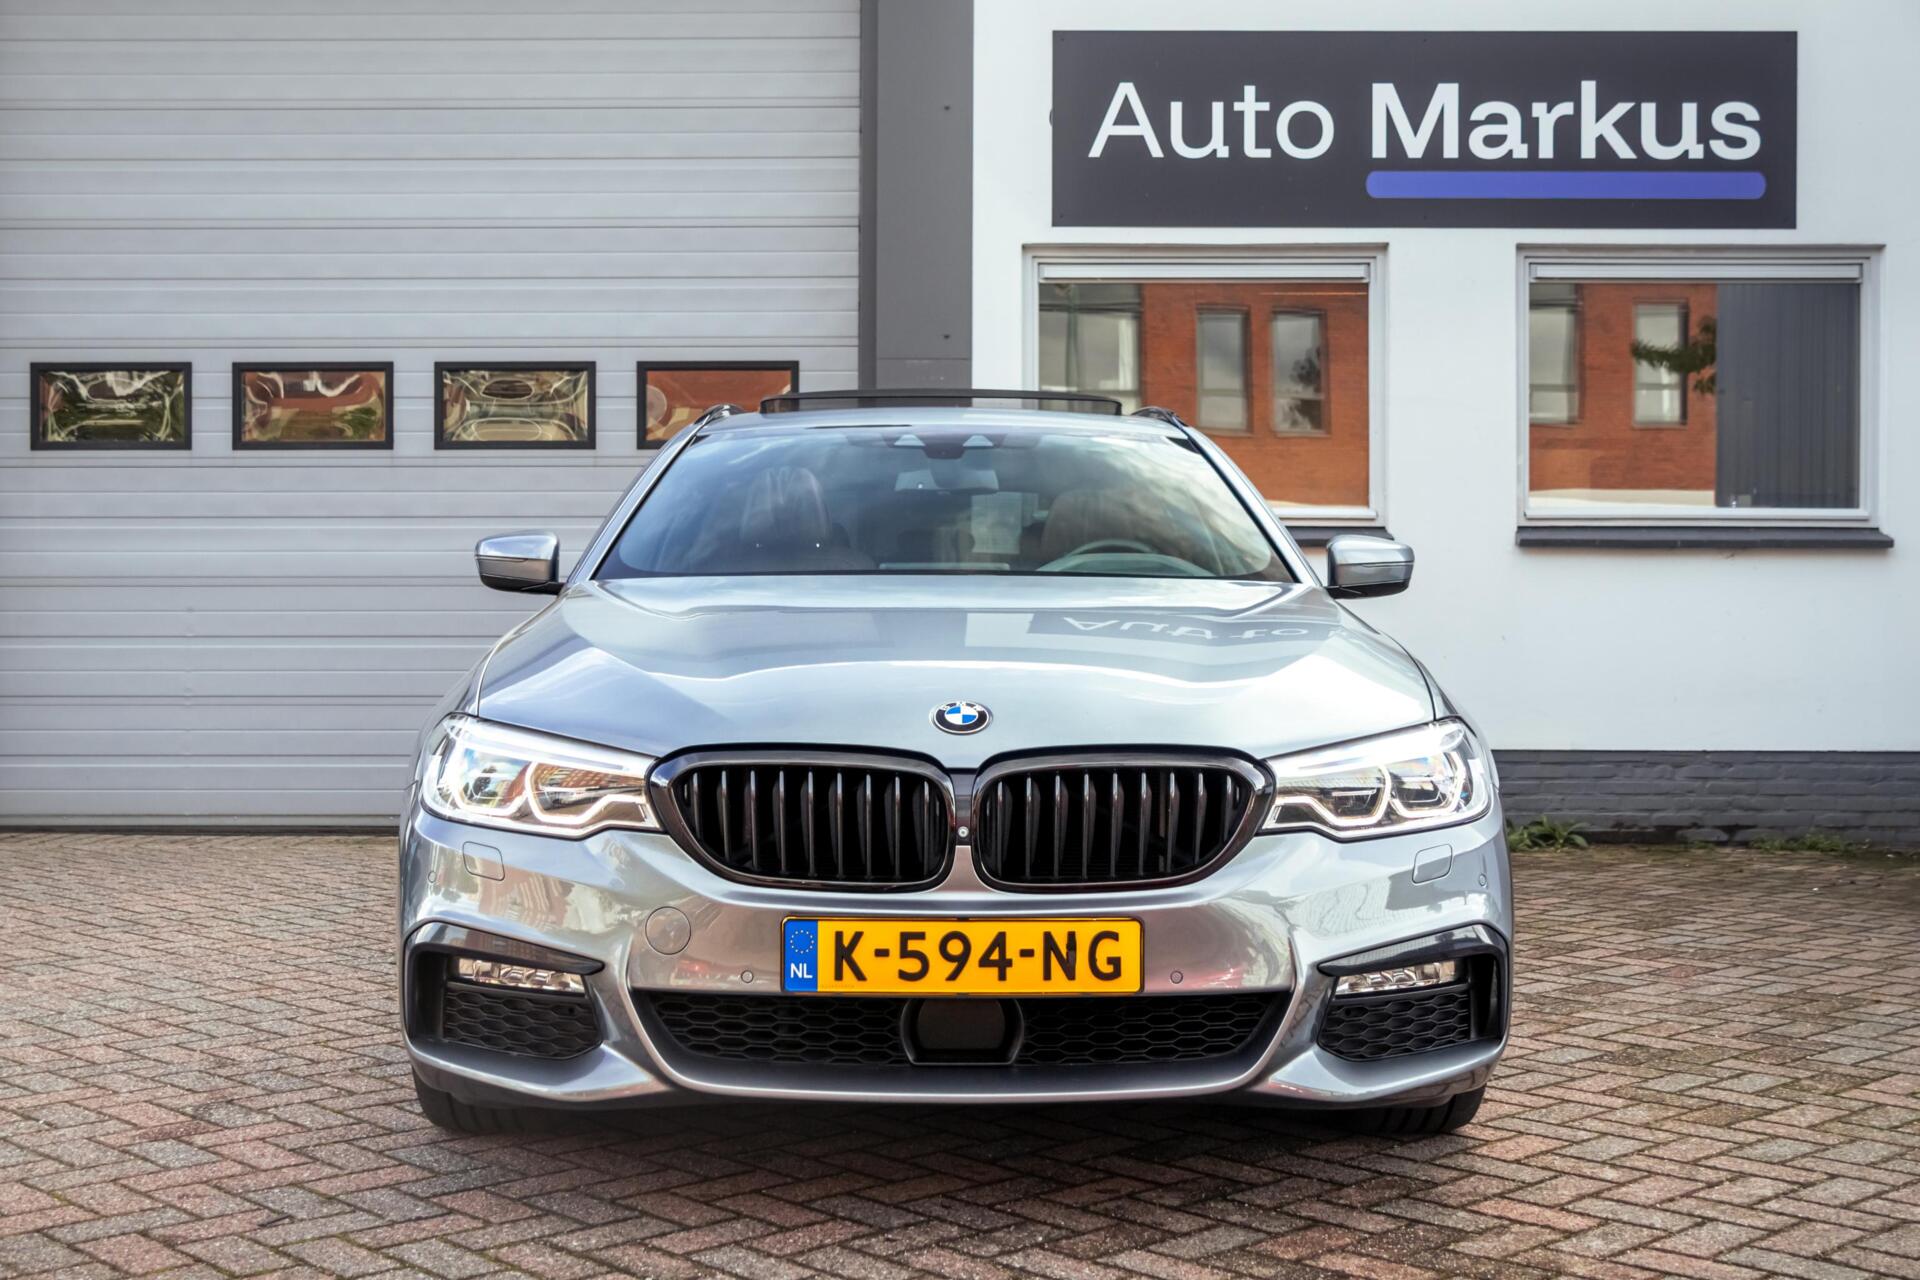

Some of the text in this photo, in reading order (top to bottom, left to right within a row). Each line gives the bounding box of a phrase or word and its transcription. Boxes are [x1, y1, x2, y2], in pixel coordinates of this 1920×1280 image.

[1088, 80, 1761, 160] Auto Markus
[790, 963, 812, 979] NL
[833, 930, 1122, 982] K-594-NG
